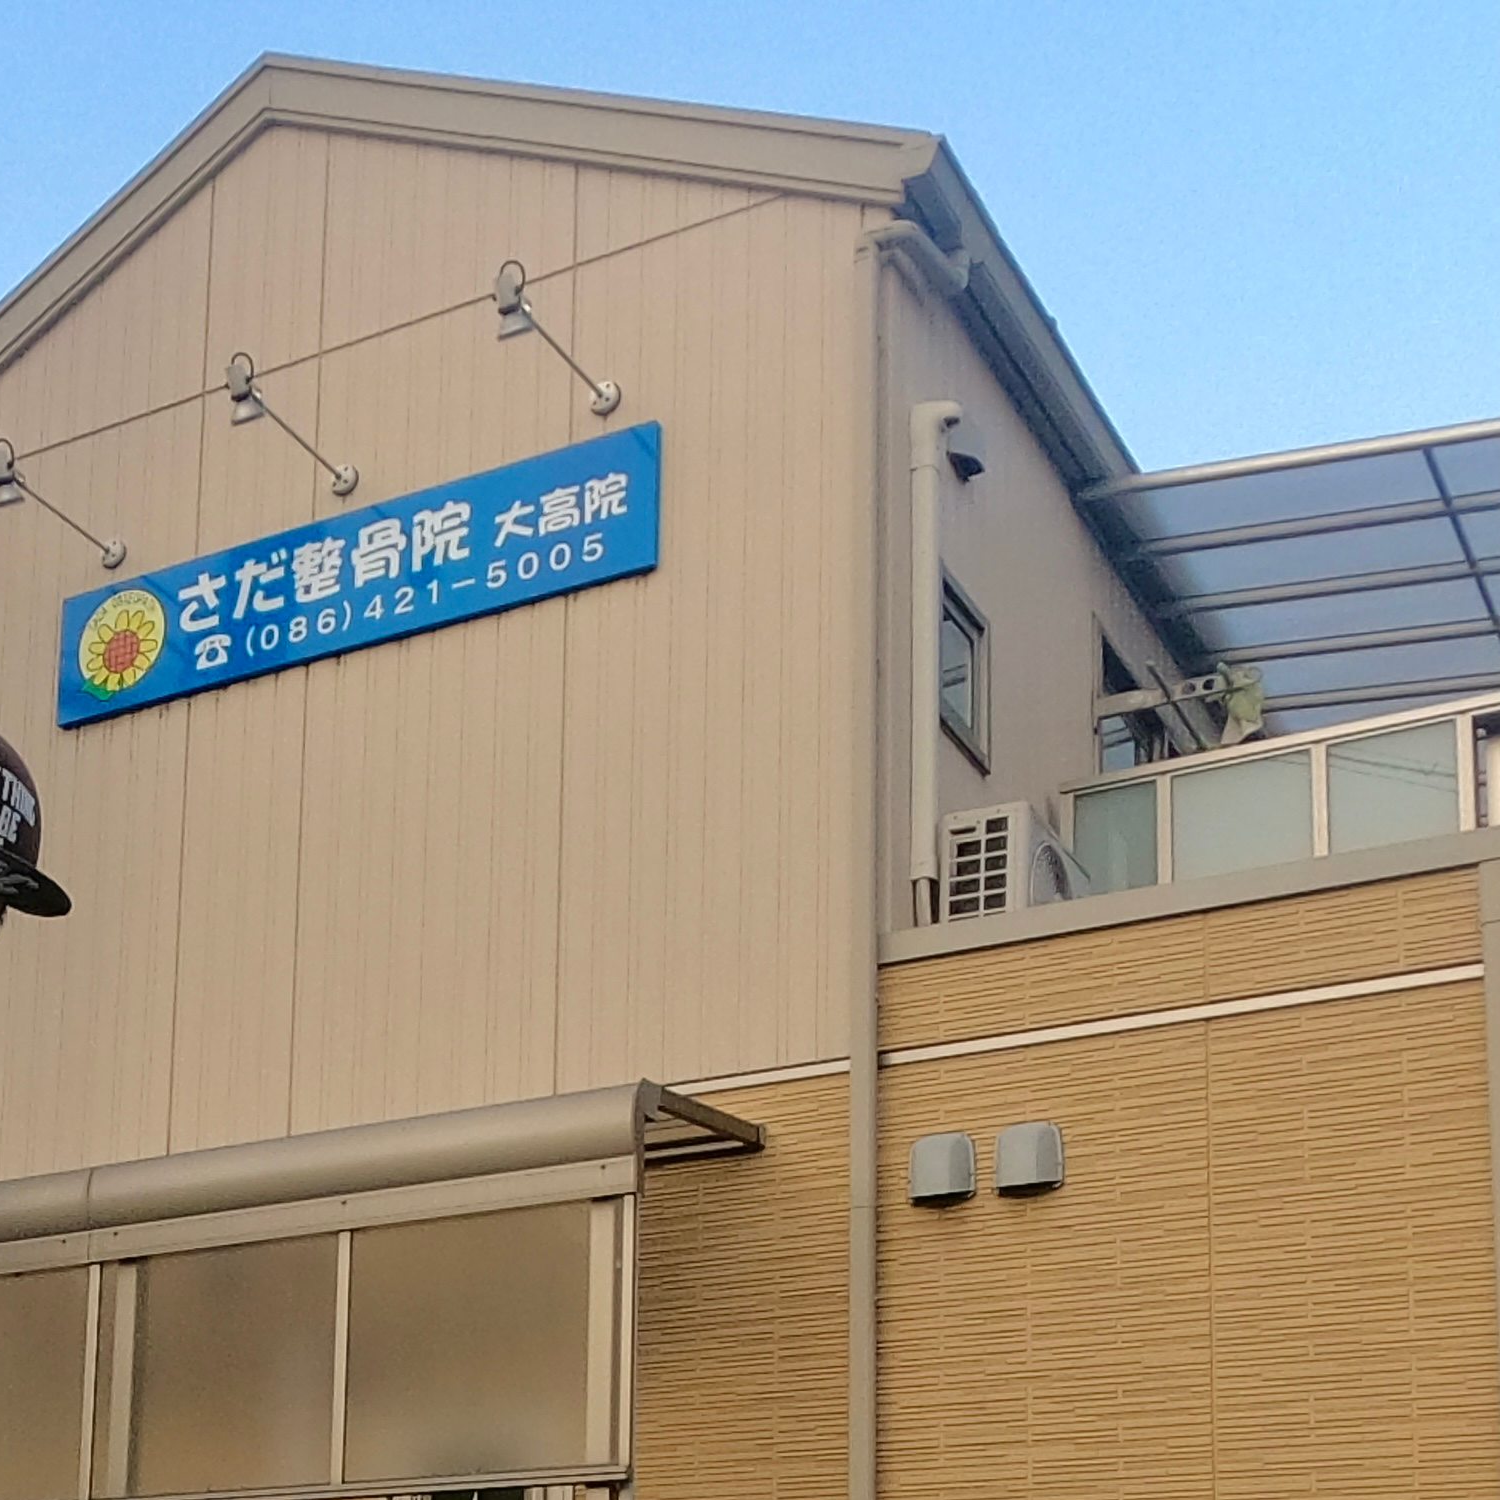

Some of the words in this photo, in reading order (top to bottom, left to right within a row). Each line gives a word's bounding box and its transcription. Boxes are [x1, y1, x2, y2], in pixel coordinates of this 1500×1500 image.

[177, 498, 471, 632] さだ整骨院
[494, 472, 629, 548] 大高院
[246, 533, 605, 657] (086)421-5005
